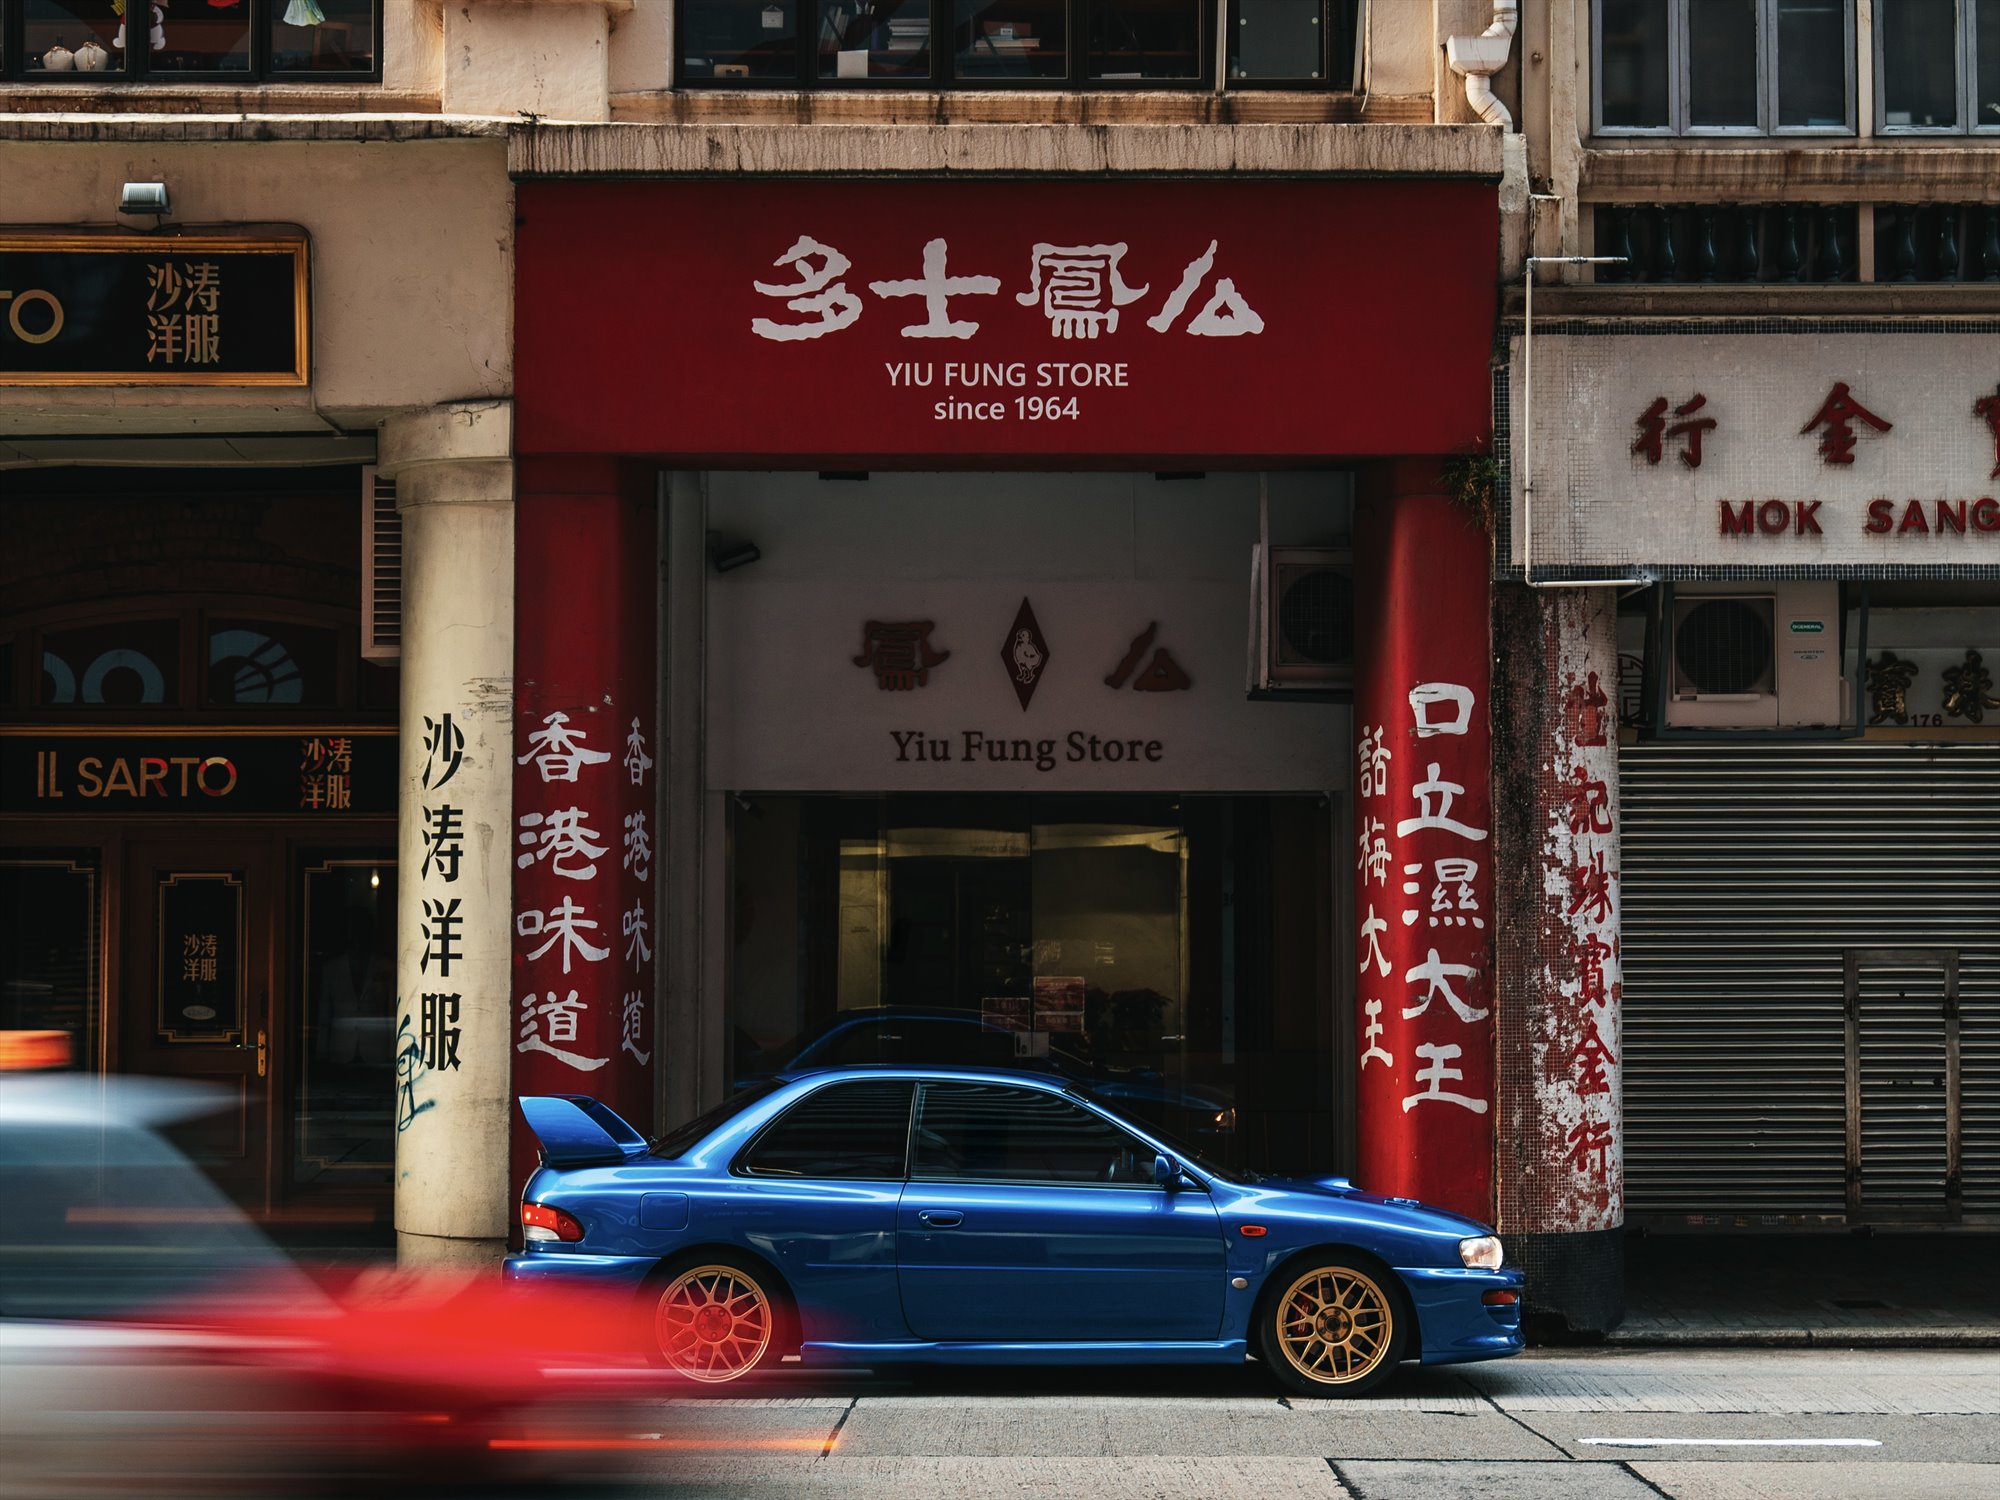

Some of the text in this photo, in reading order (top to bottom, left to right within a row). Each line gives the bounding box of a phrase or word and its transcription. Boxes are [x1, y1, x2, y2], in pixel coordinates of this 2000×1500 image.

[885, 362, 1129, 387] YIU FUNG STORE
[934, 395, 1080, 420] since 1964
[1718, 497, 2000, 536] MOK SANG
[1910, 714, 1943, 728] 176
[889, 730, 1164, 772] Yiu Fung Store
[36, 751, 238, 798] IL SARTO
[419, 712, 465, 1072] 沙涛洋服
[516, 711, 612, 1072] 香港味道
[621, 715, 653, 1066] 香港味道
[1357, 725, 1394, 1070] 話梅大王
